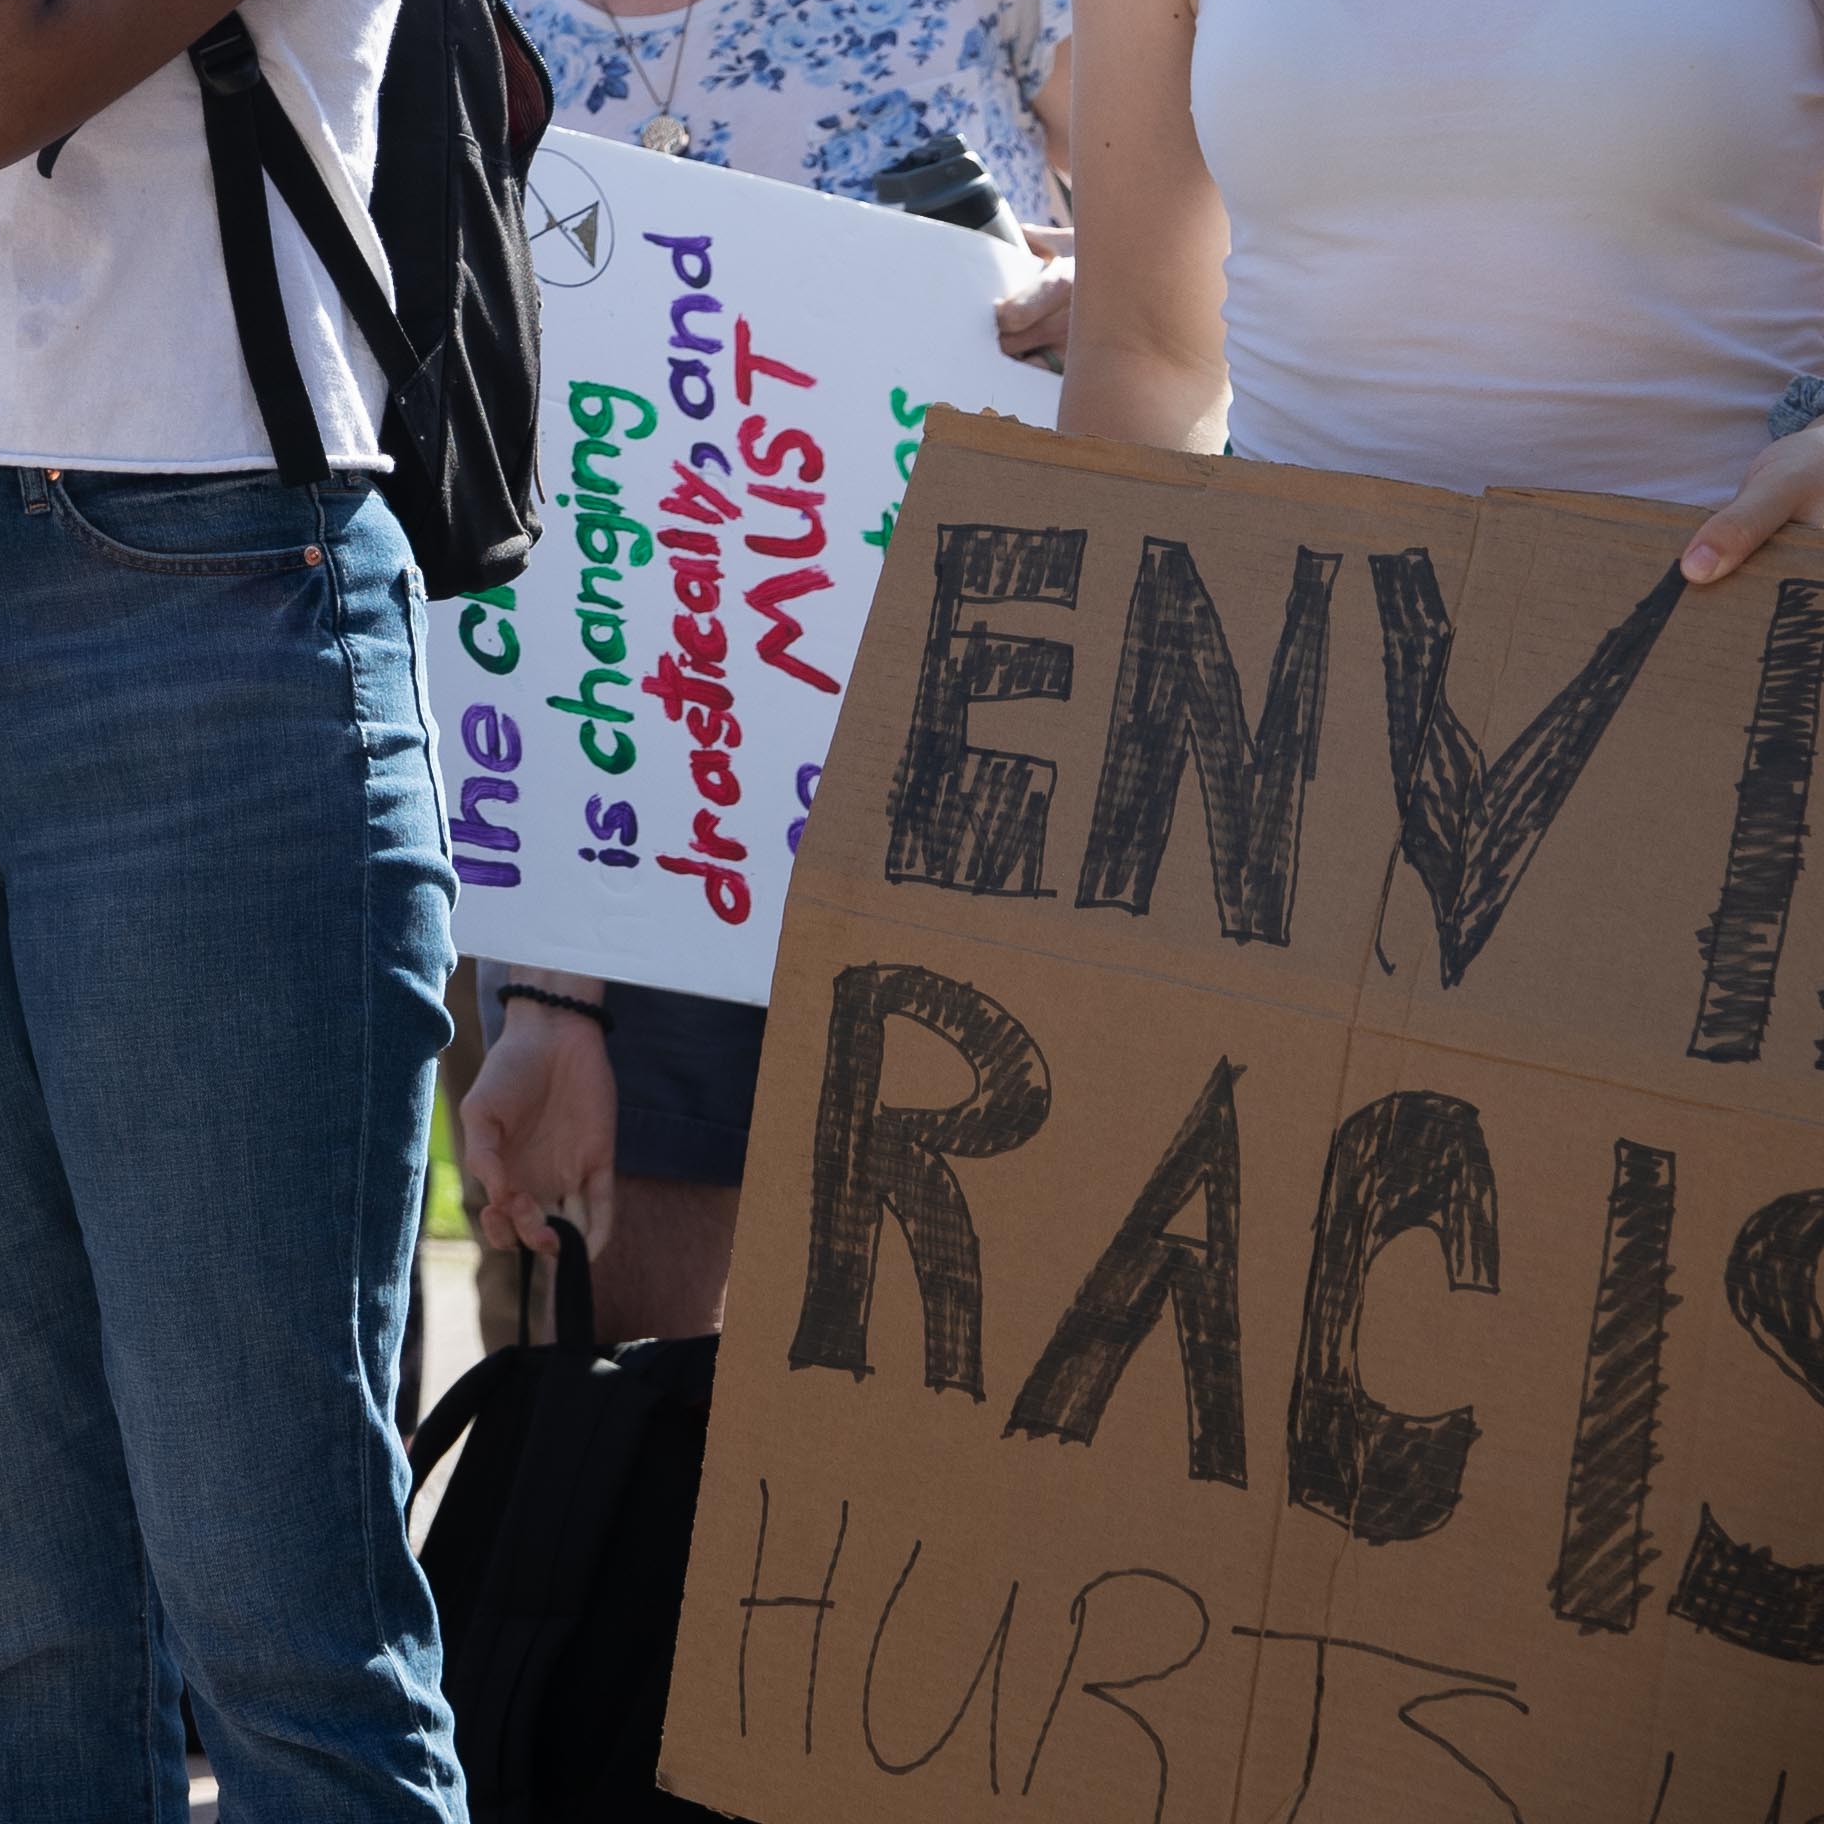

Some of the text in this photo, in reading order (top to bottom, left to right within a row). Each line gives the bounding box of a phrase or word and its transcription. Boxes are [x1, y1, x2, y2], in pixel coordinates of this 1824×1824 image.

[642, 232, 725, 421] and
[734, 313, 842, 697] MUST
[547, 380, 657, 776] changing
